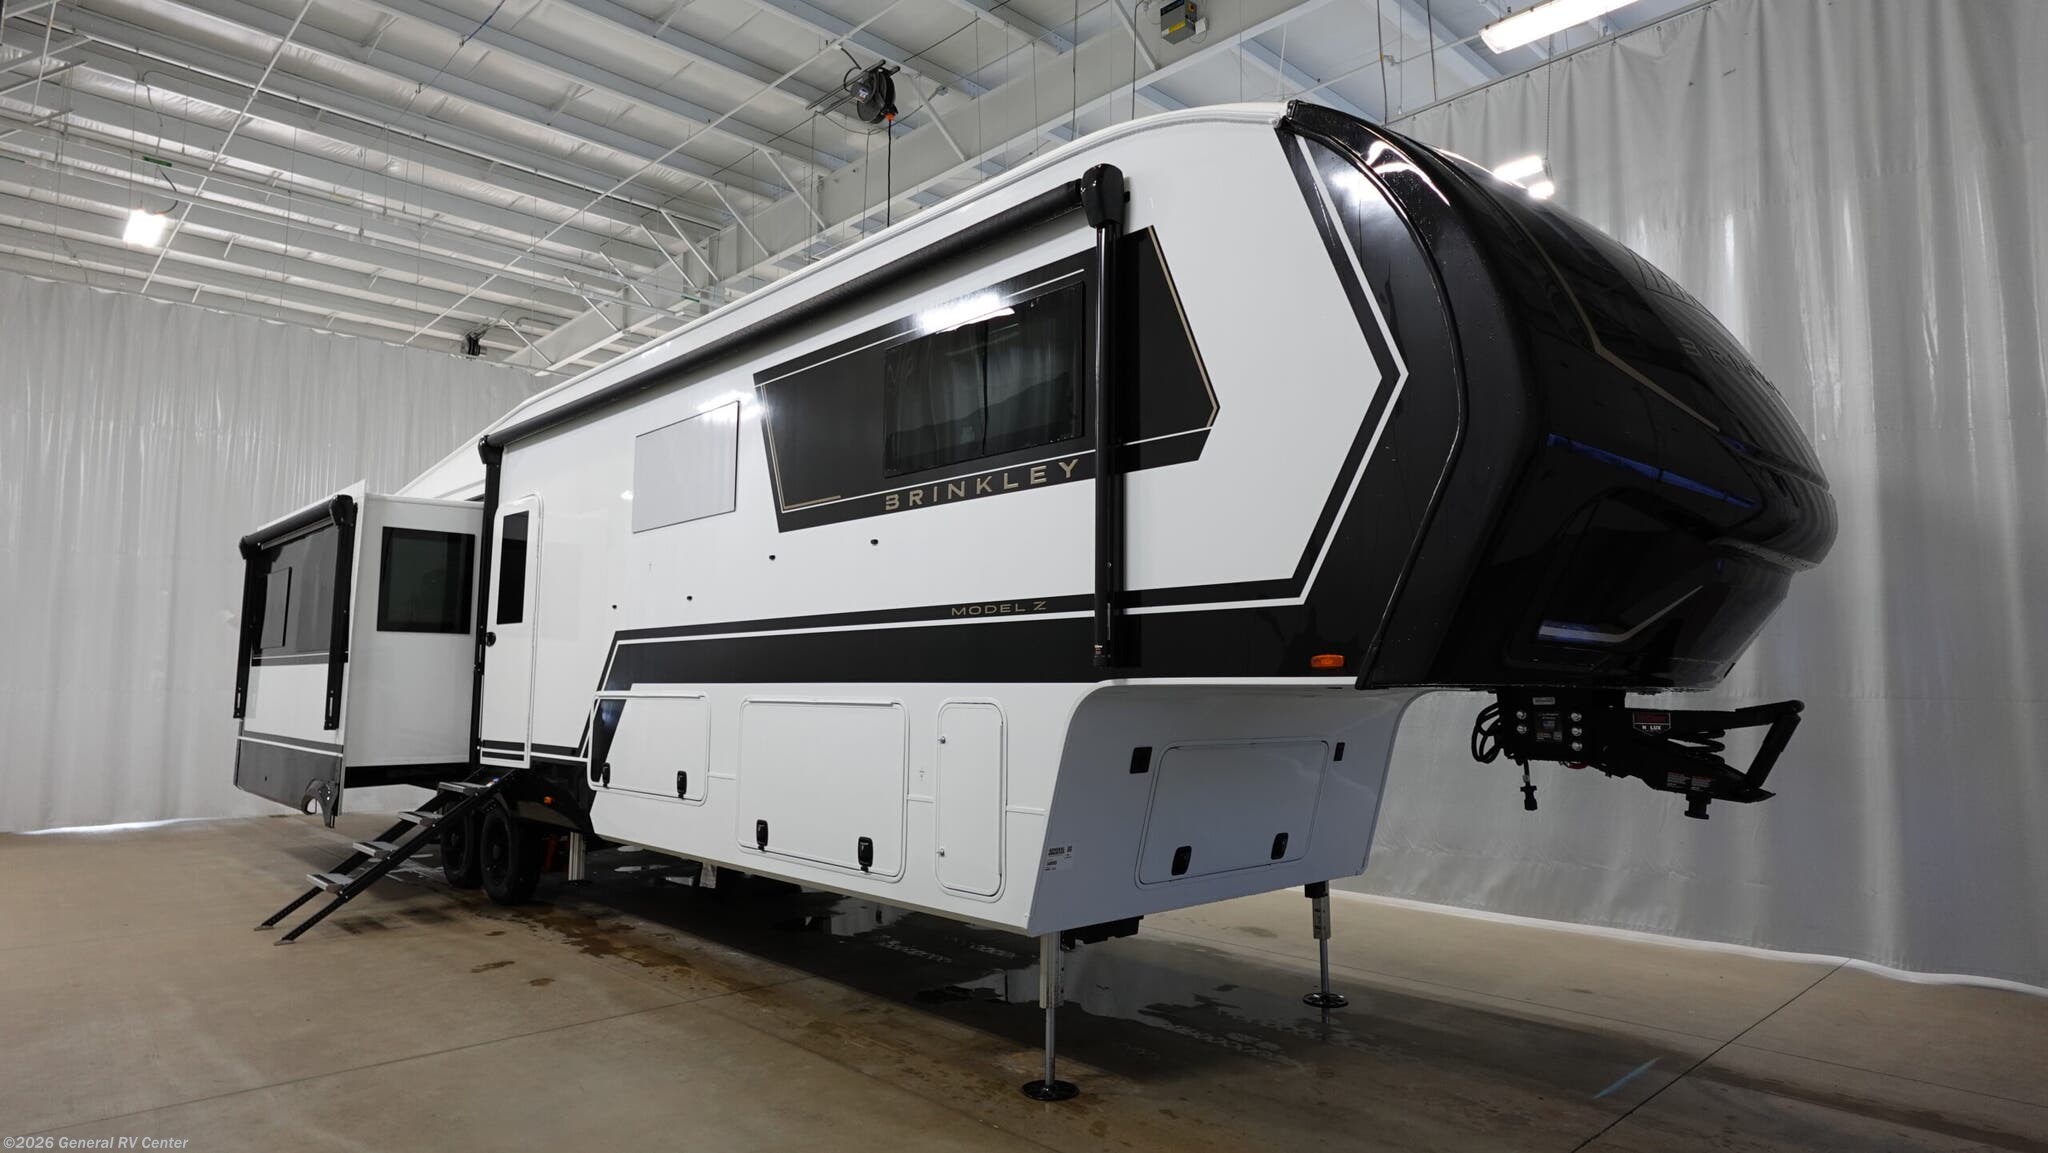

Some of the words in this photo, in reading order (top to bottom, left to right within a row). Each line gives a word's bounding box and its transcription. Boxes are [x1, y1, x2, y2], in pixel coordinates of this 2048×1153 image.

[885, 458, 1079, 511] BRINKLEY
[951, 604, 1026, 616] MODEL
[1033, 601, 1047, 611] Z
